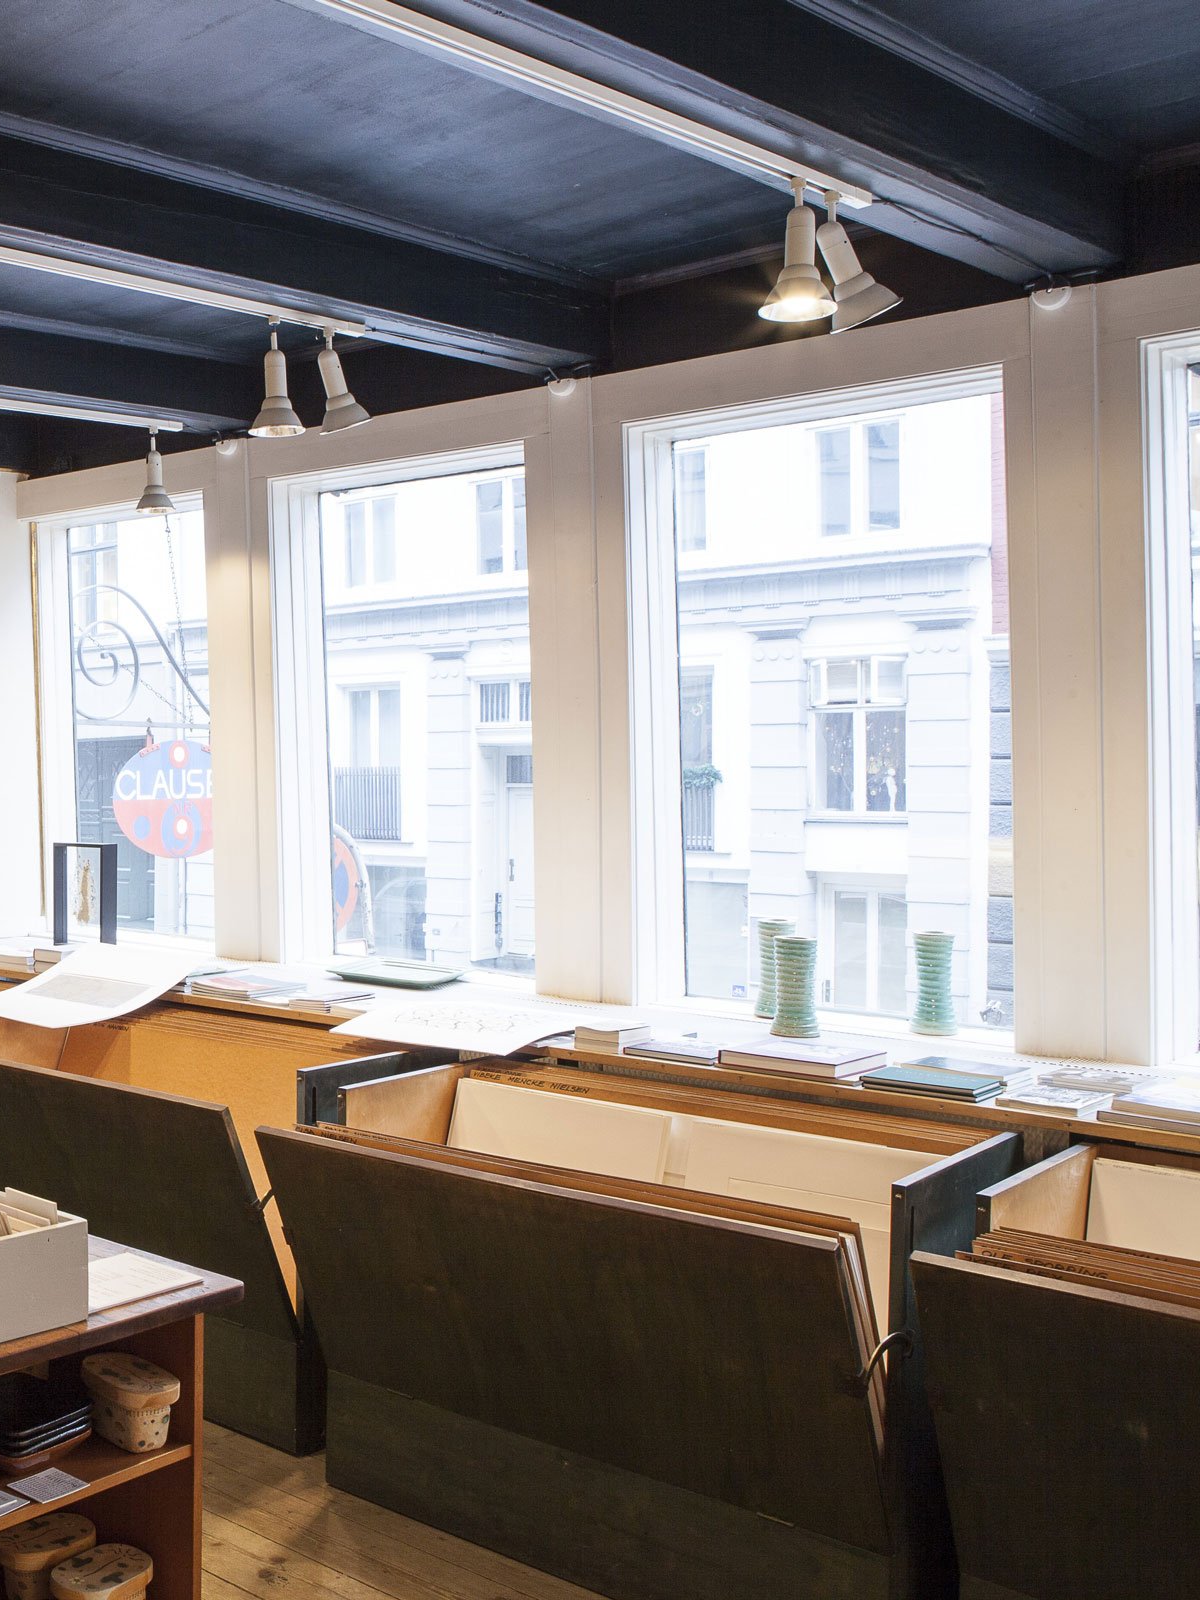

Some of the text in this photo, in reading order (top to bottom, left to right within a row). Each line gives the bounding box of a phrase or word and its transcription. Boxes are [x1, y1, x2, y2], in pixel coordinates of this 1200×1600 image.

[473, 1071, 502, 1081] VIBEKE
[507, 1076, 545, 1088] MENCKE
[550, 1082, 590, 1094] NIELSEN
